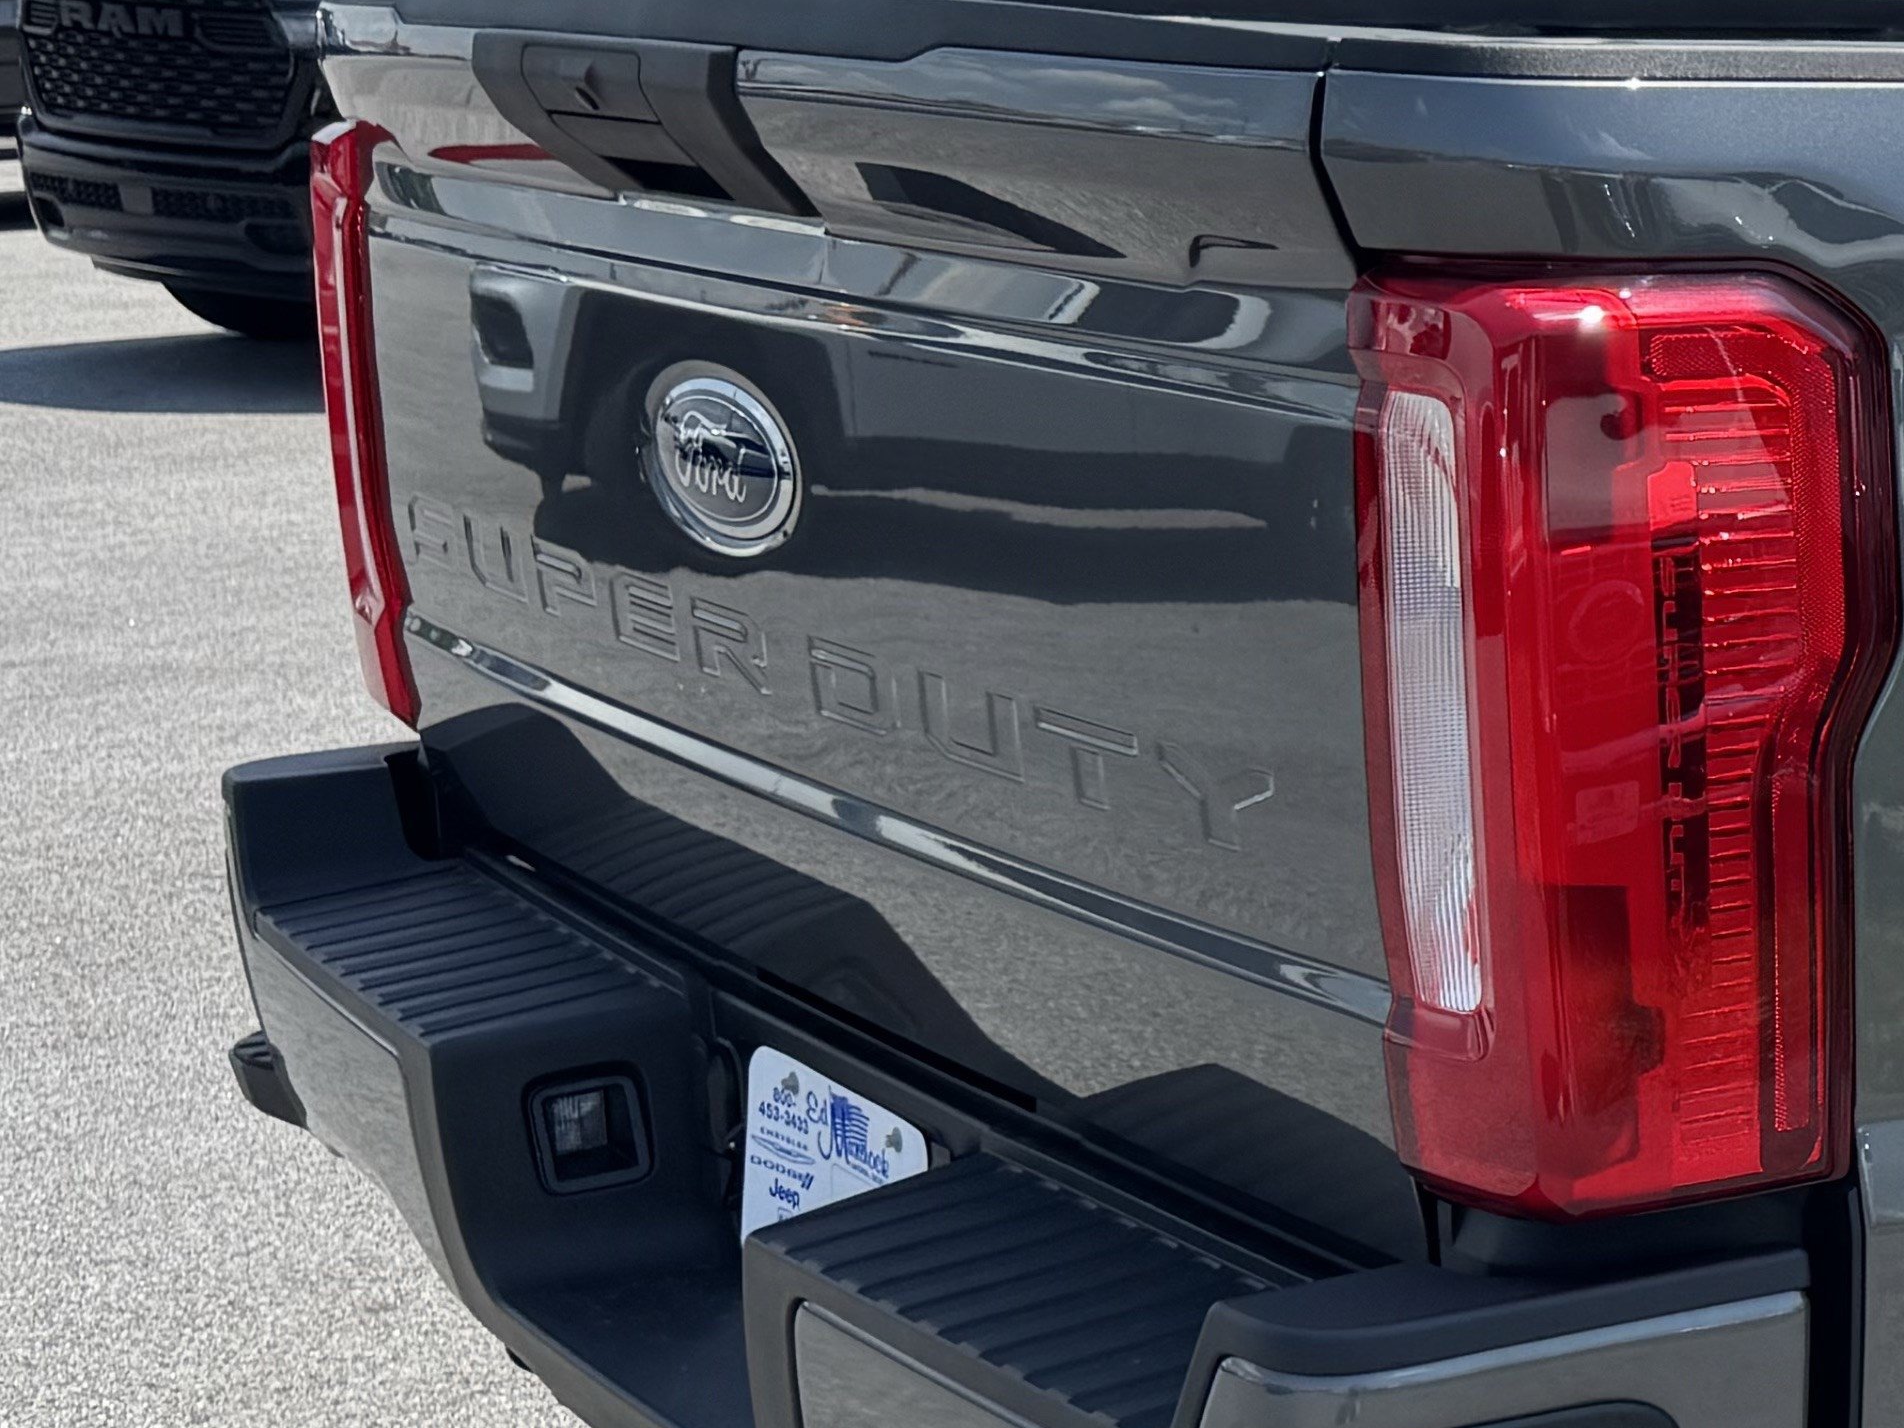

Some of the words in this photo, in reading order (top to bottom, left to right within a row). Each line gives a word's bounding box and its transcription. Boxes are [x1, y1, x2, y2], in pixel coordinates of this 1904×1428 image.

[675, 410, 750, 503] Ford
[408, 492, 771, 695] SUPER
[808, 635, 1276, 852] DUTY
[806, 1090, 828, 1126] Ed
[769, 1177, 800, 1210] Jeep
